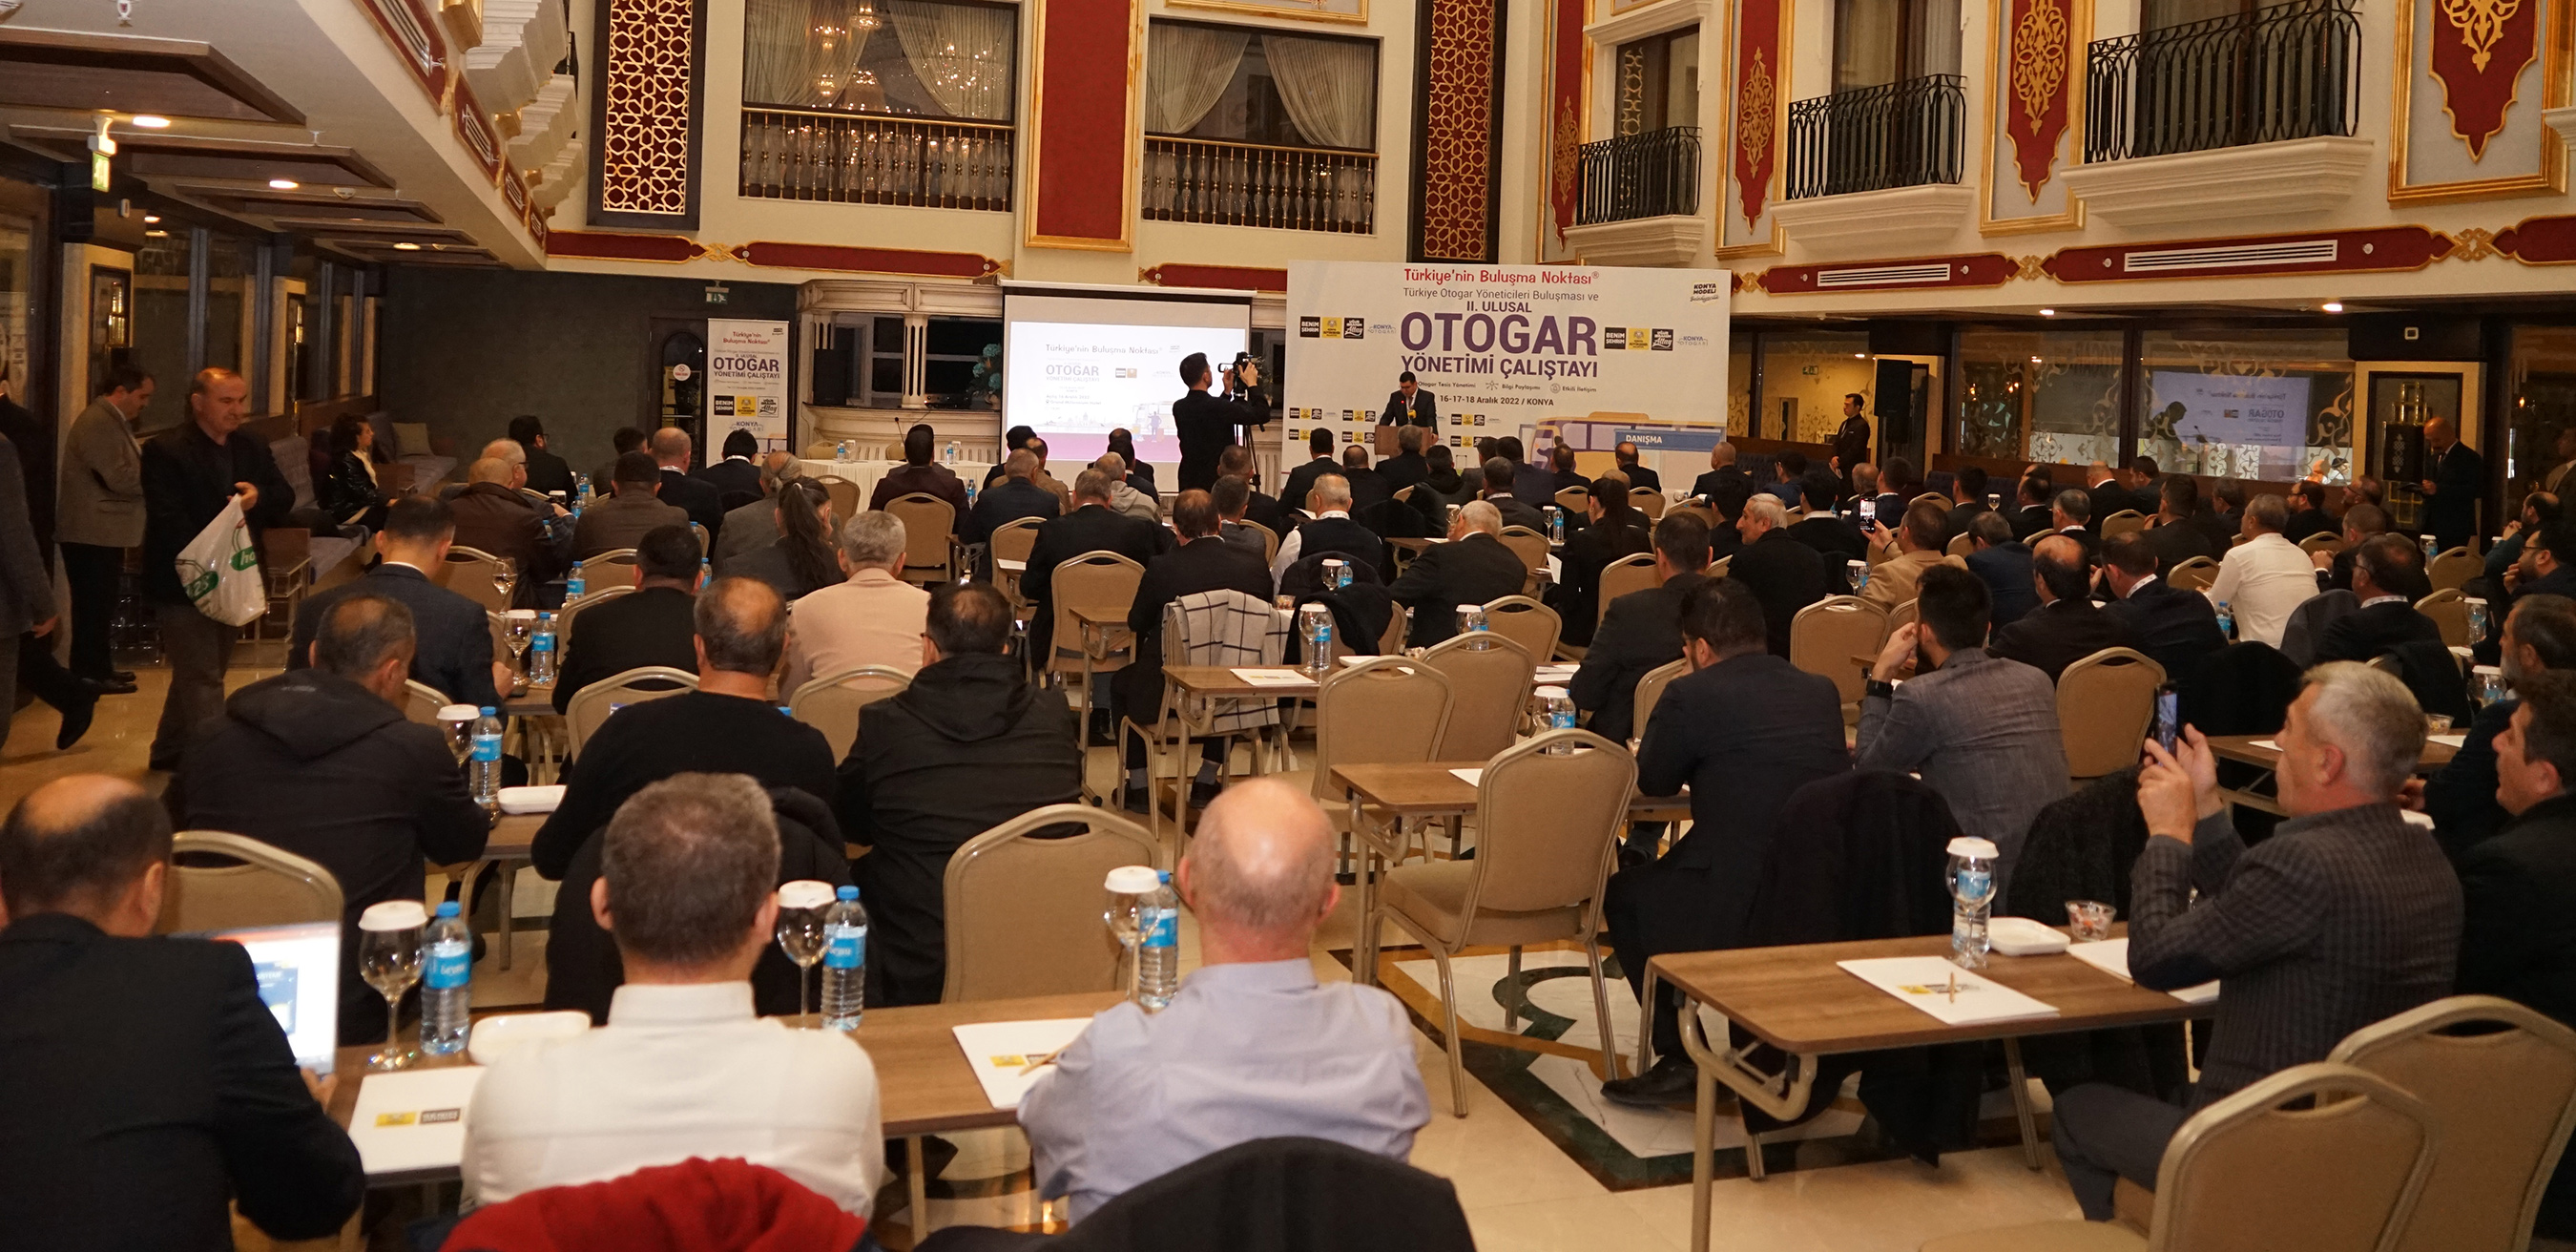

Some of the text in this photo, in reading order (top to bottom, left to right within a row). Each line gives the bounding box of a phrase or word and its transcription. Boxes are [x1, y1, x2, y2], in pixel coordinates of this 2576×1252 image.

[1404, 269, 1474, 285] Türkiye'nin
[1480, 270, 1536, 286] Buluşma
[1404, 288, 1437, 300] Türkiye
[1441, 289, 1473, 300] Otogar
[1476, 290, 1530, 299] Yöneticileri
[1533, 291, 1584, 302] Buluşması
[1467, 301, 1532, 313] II. ULUSAL
[1401, 312, 1597, 355] OTOGAR
[1046, 344, 1089, 353] Türkiye'nin
[1092, 345, 1126, 355] Buluşma
[713, 357, 779, 372] OTOGAR
[1046, 364, 1099, 376] OTOGAR
[1401, 353, 1598, 380] YÖNETİMİ ÇALIŞTAYI
[1626, 435, 1662, 445] DANIŞMA
